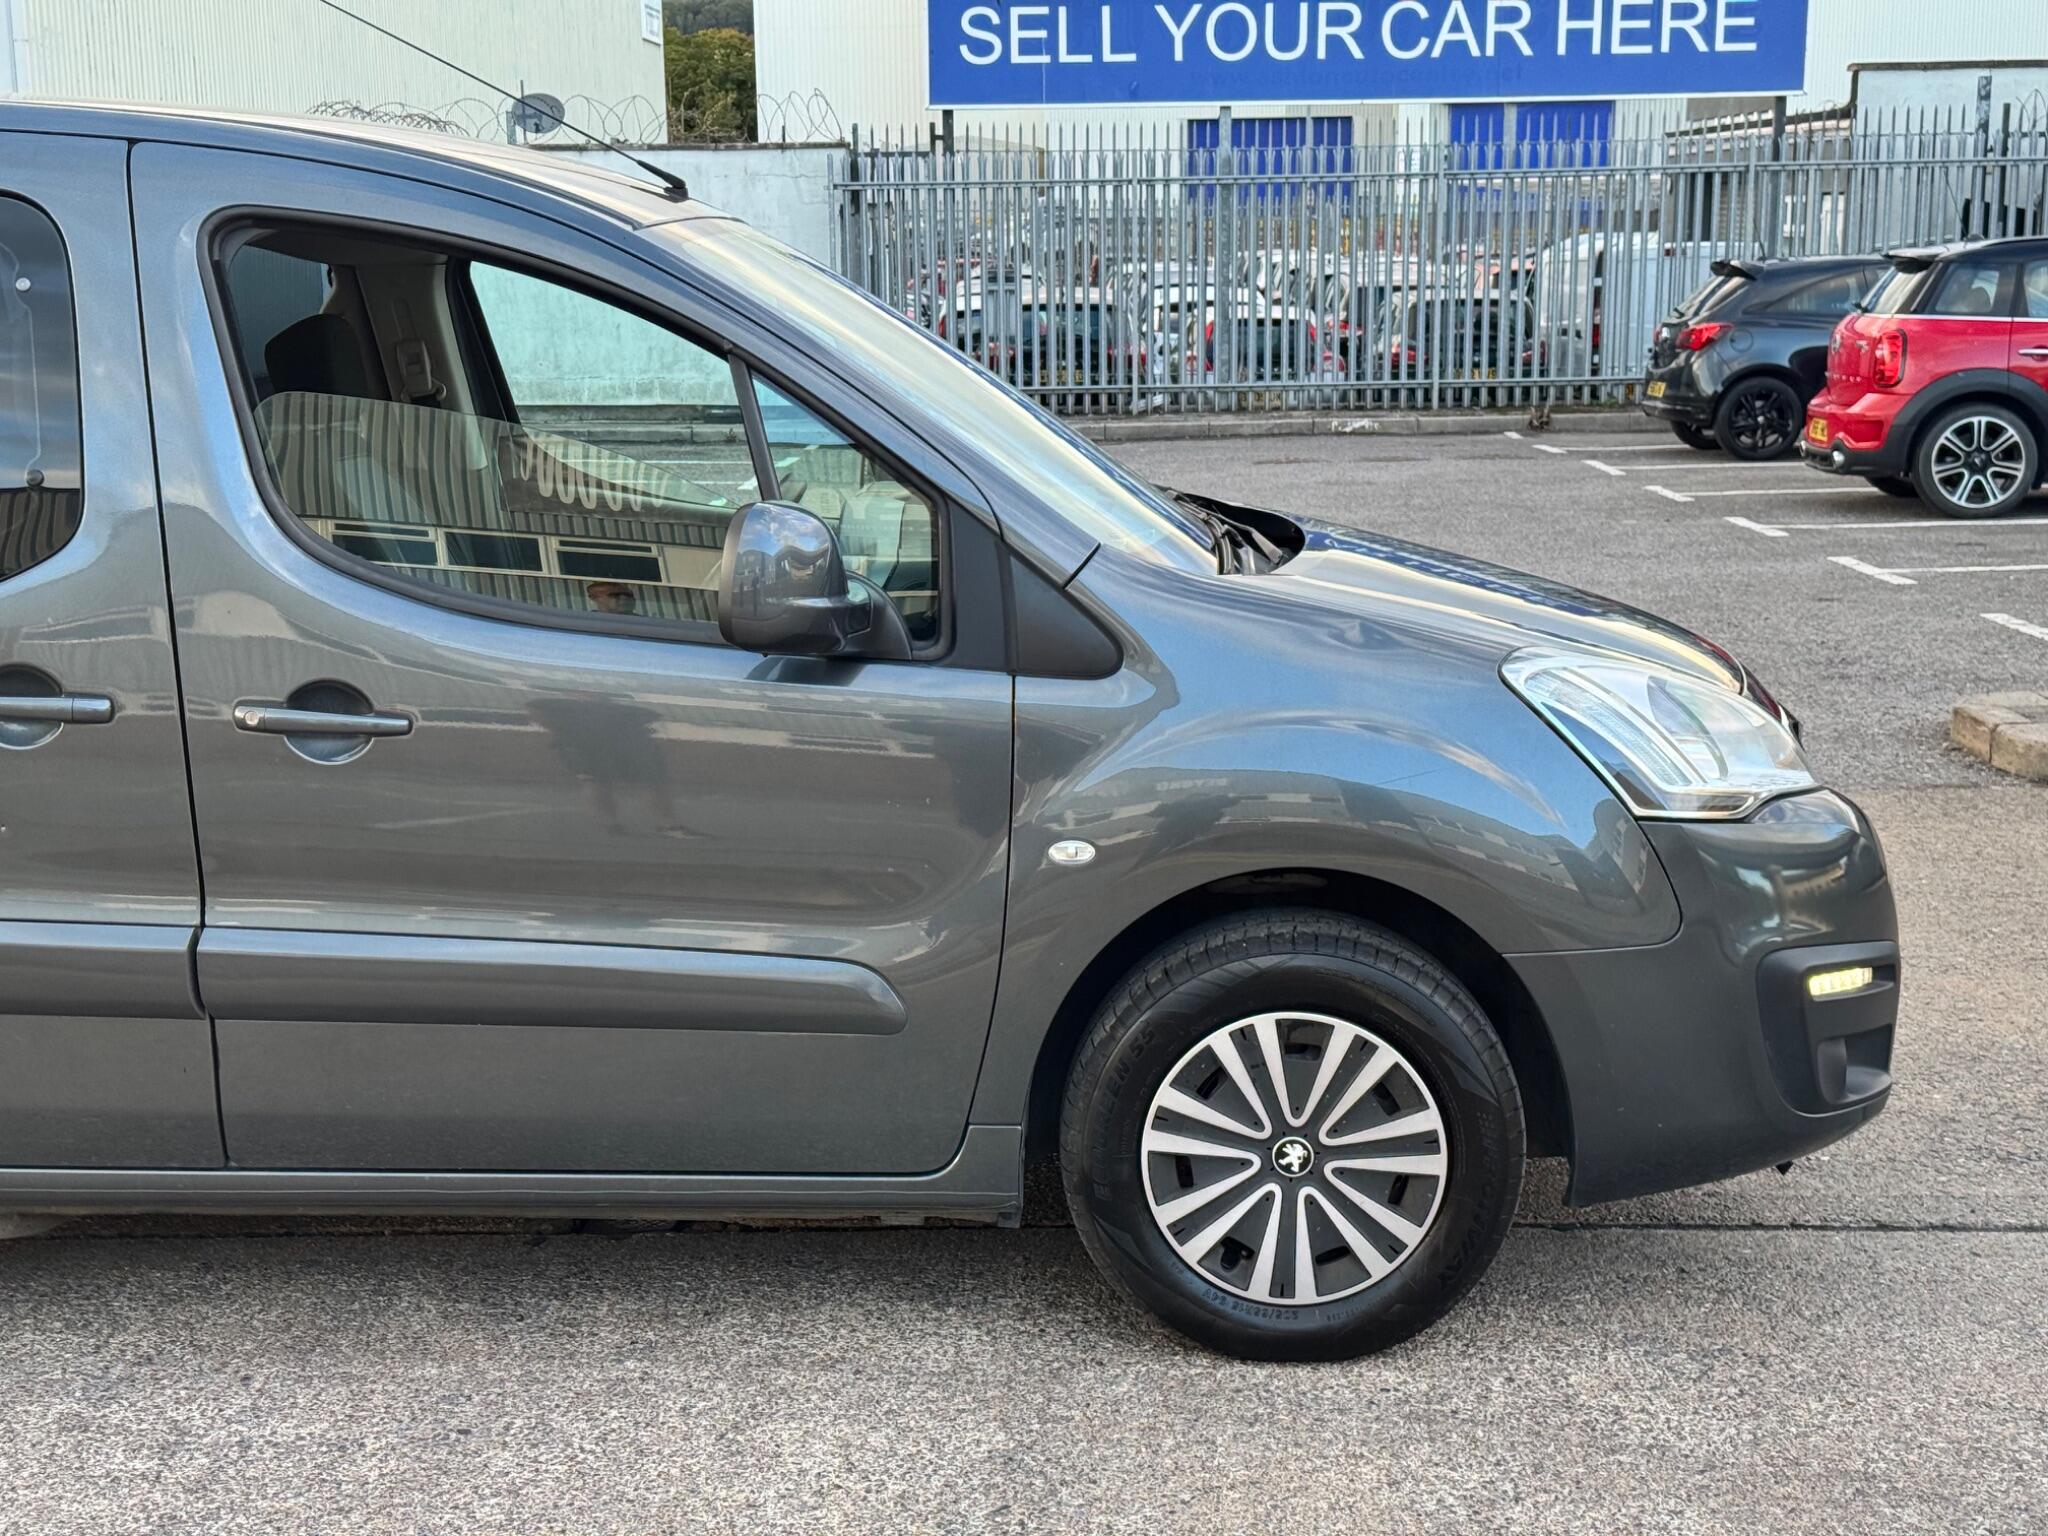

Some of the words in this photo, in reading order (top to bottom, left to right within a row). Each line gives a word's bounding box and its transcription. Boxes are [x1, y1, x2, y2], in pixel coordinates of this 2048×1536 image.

[959, 5, 1137, 65] SELL
[1154, 2, 1365, 62] YOUR
[1381, 0, 1534, 60] CAR
[1556, 0, 1758, 56] HERE
